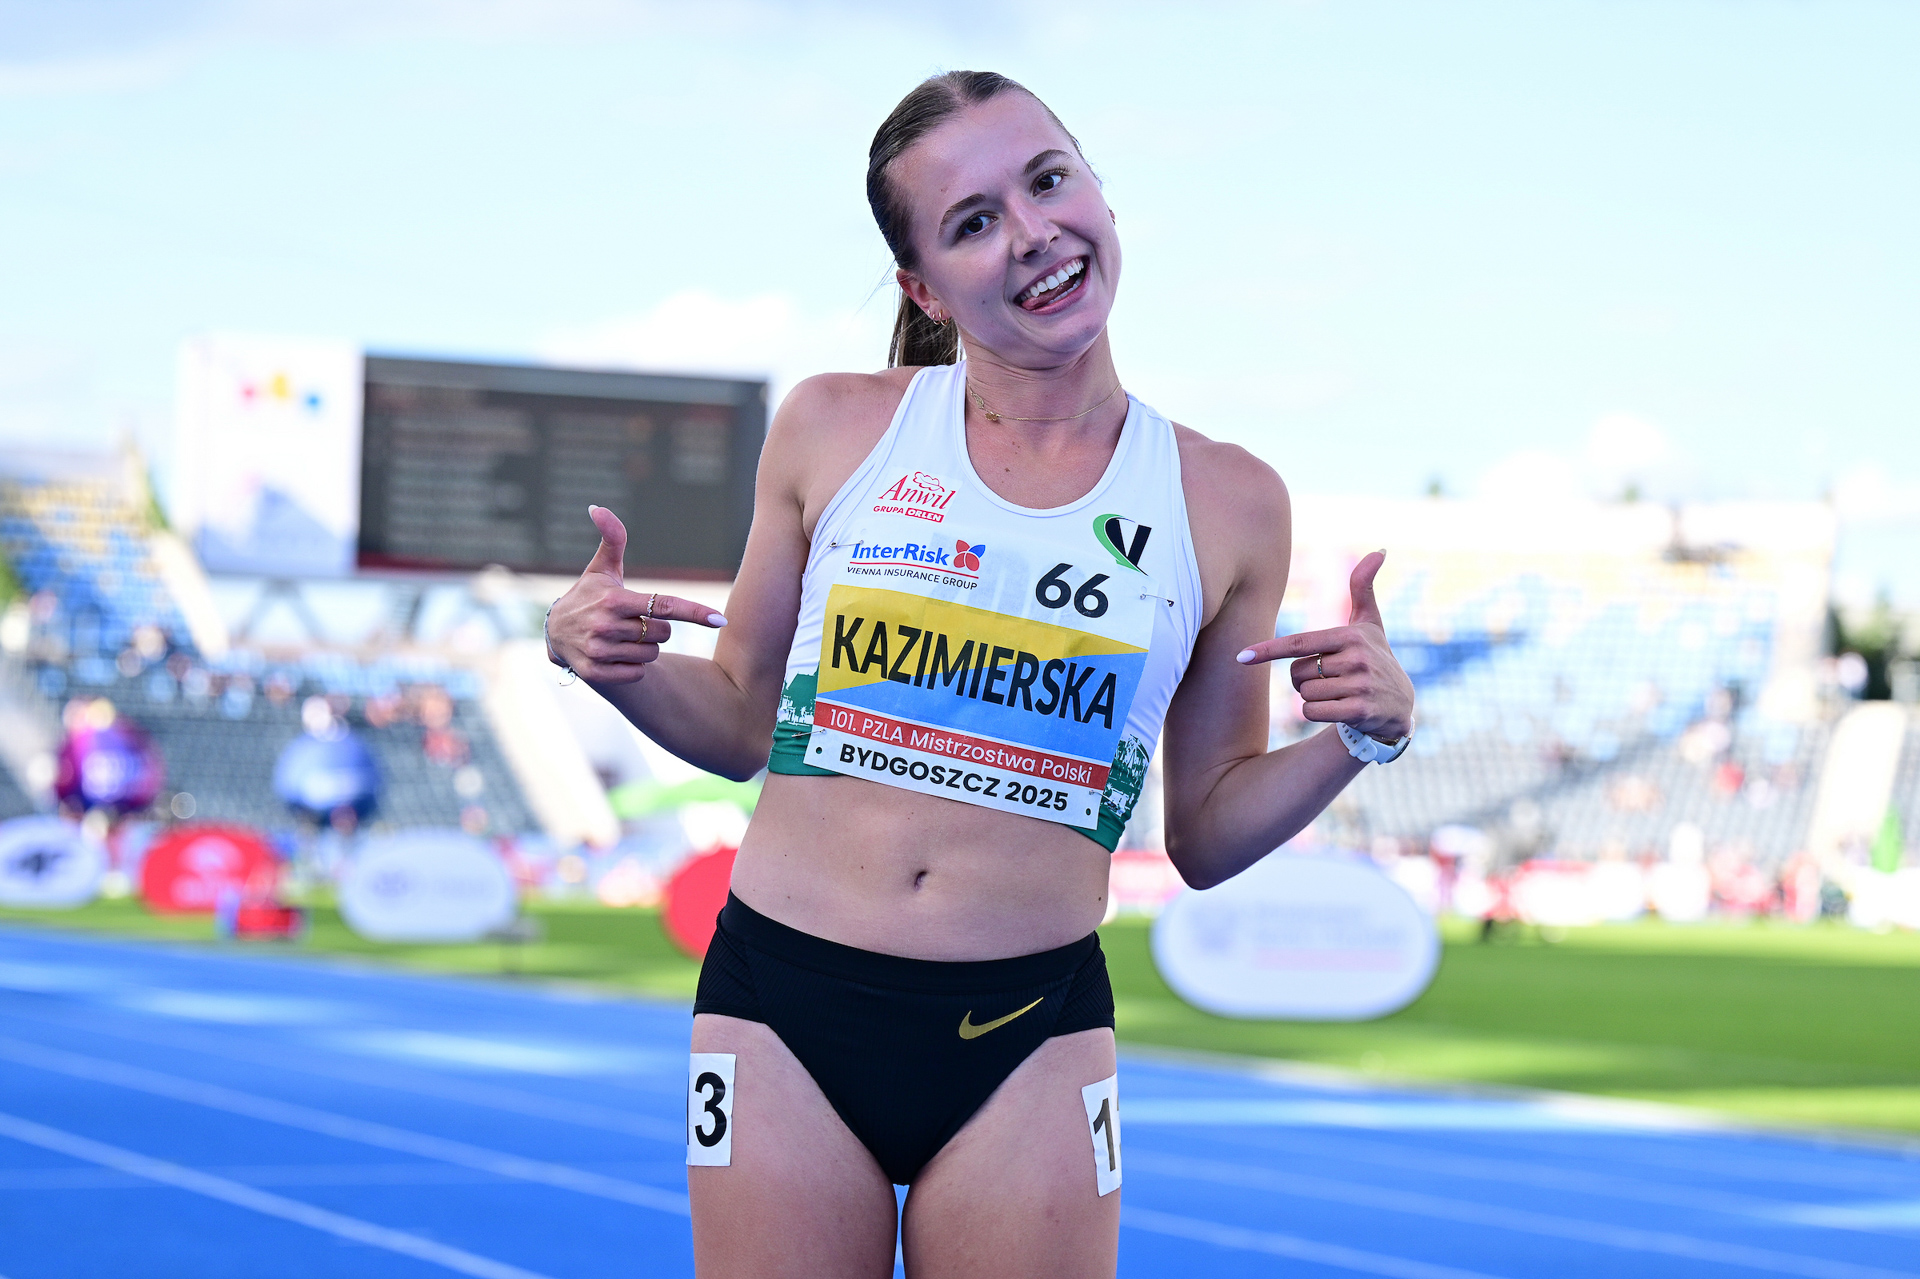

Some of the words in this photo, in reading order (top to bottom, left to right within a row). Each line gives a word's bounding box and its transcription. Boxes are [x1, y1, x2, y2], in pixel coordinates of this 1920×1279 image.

[873, 505, 904, 514] GRUPA
[907, 509, 942, 523] ORLEN
[878, 475, 956, 509] Anwil
[847, 566, 881, 576] VIENNA
[884, 568, 941, 583] INSURANCE
[942, 576, 978, 591] GROUP
[852, 543, 950, 566] InterRisk
[1035, 562, 1110, 618] 66
[831, 614, 1117, 729] KAZIMIERSKA
[830, 708, 857, 732] 101.
[861, 719, 904, 744] PZLA
[909, 728, 1036, 772] Mistrzostwa
[1040, 758, 1093, 785] Polski
[839, 743, 1001, 798] BYDGOSZCZ
[1004, 780, 1069, 812] 2025
[686, 1071, 728, 1148] 3
[1092, 1097, 1121, 1172] 1
